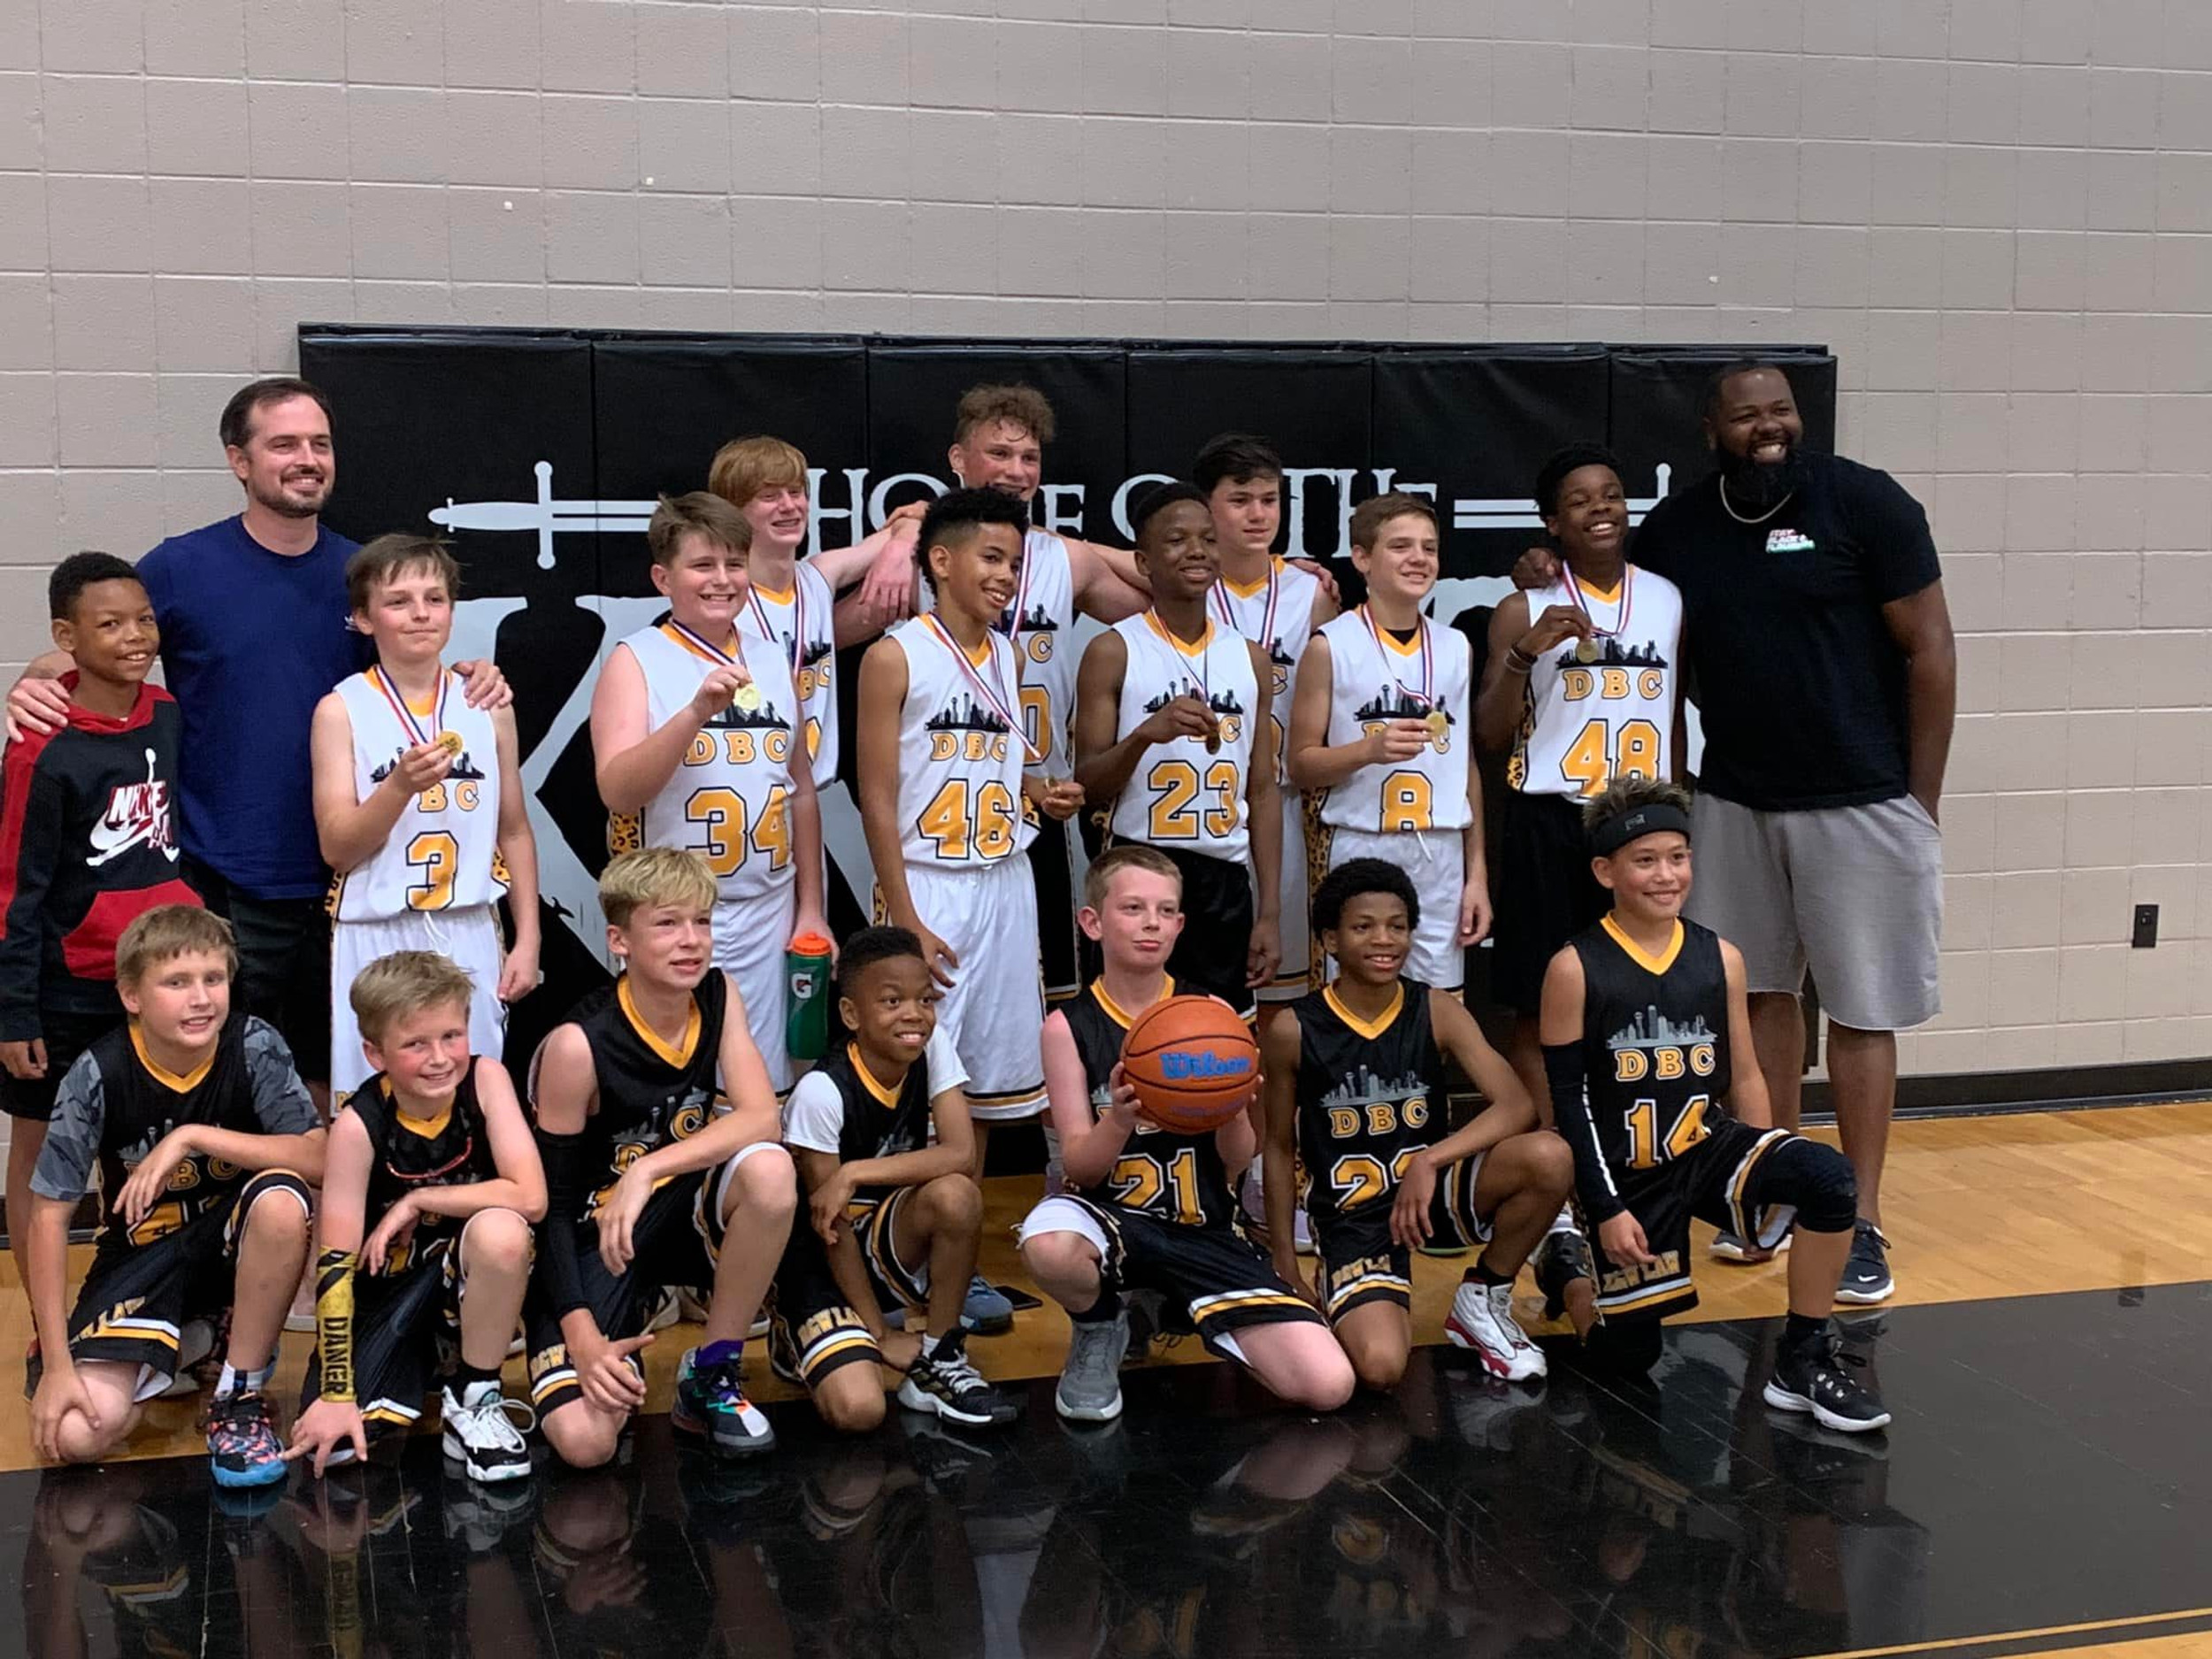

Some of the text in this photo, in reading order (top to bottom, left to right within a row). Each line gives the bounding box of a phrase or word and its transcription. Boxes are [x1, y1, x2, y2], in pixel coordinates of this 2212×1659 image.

[806, 468, 1086, 554] HOE
[1563, 668, 1663, 702] DBC
[683, 730, 787, 766] DBC
[930, 731, 1009, 763] DBC
[1559, 718, 1662, 801] 48
[417, 780, 480, 813] BC
[685, 783, 789, 878] 34
[917, 778, 1015, 861] 46
[1148, 759, 1240, 840] 23
[1381, 769, 1433, 832] 8
[405, 830, 459, 912] 3
[1615, 1043, 1717, 1081] DBC
[1328, 1097, 1429, 1139] DBC
[1624, 1093, 1712, 1170] 14
[1108, 1147, 1206, 1227] 21
[324, 1317, 349, 1395] DANGER
